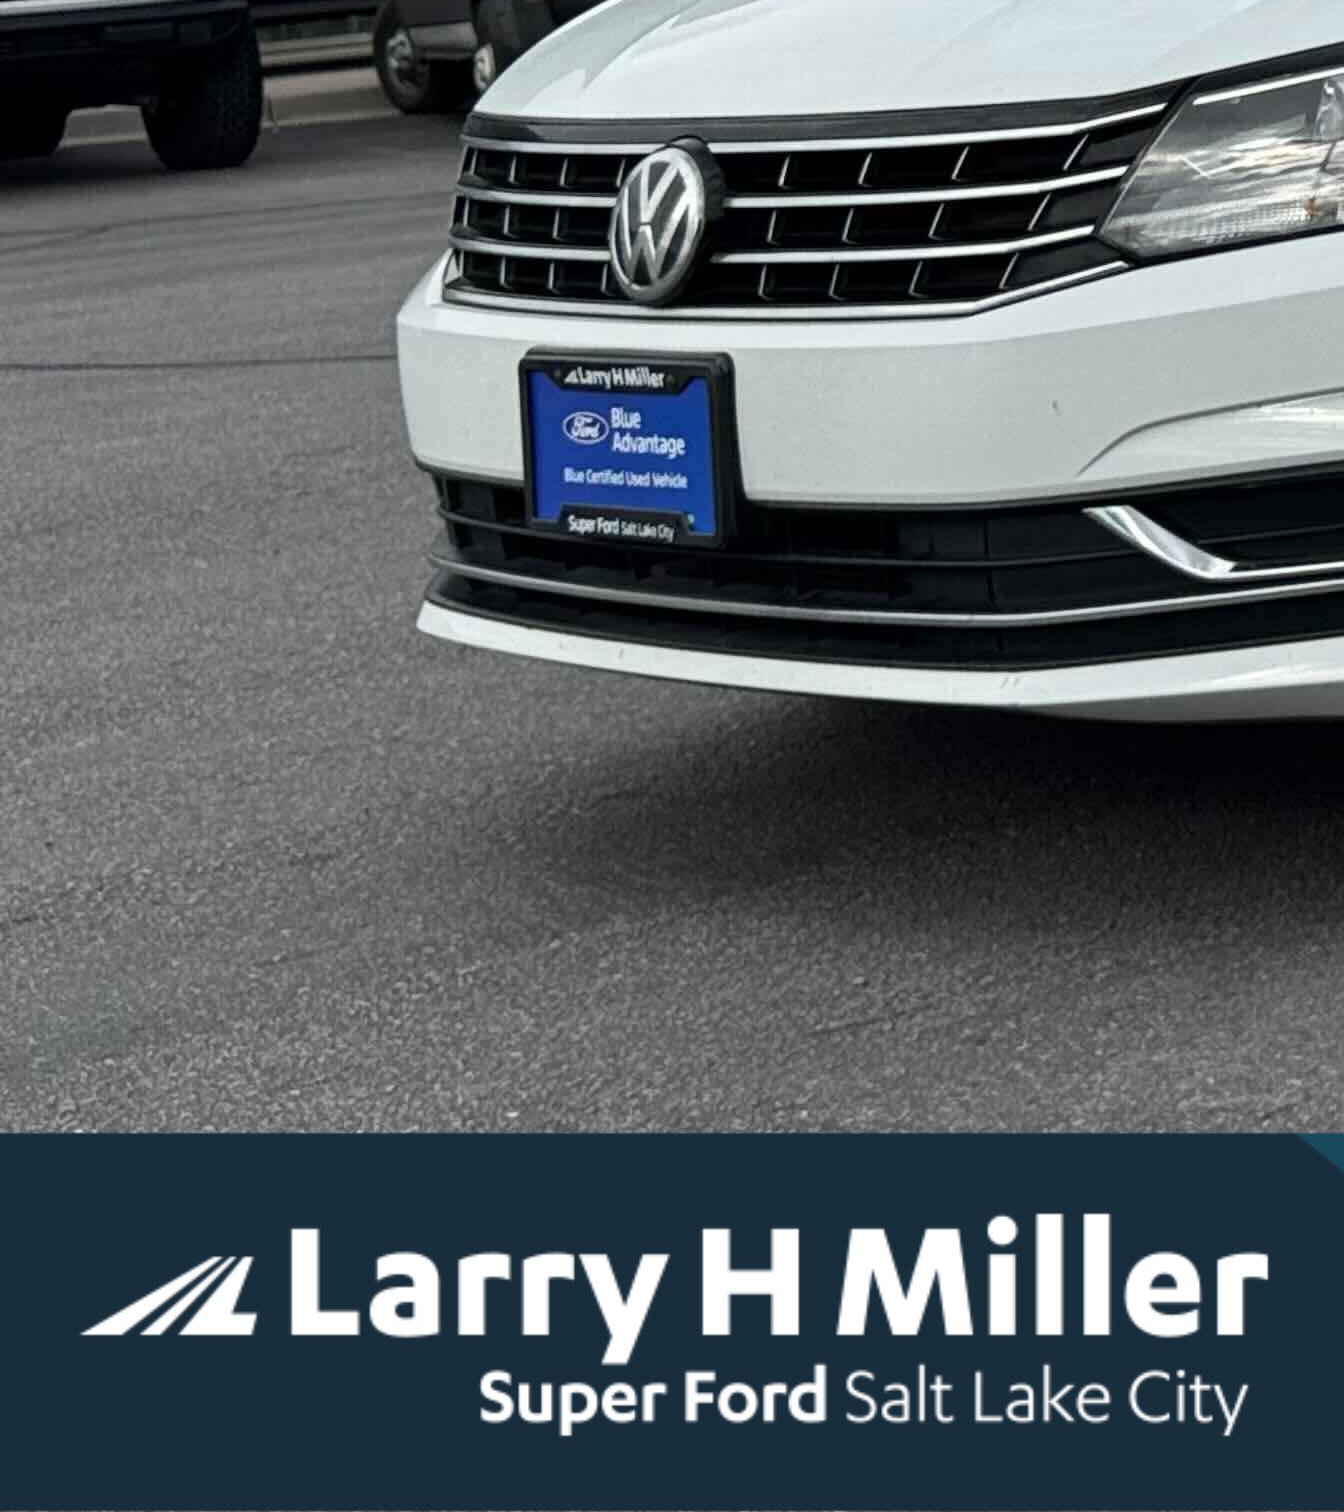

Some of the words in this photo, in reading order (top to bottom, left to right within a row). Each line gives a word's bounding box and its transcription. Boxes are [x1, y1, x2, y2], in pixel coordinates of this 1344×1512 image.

[576, 366, 611, 389] Larry
[611, 367, 624, 387] H
[624, 367, 665, 388] Miller
[611, 407, 642, 429] Blue
[611, 431, 686, 459] Advantage
[563, 467, 585, 483] Blue
[586, 469, 624, 486] Certified
[625, 471, 651, 487] Used
[652, 472, 688, 489] Vehicle
[567, 514, 596, 536] Super
[597, 517, 620, 536] Ford
